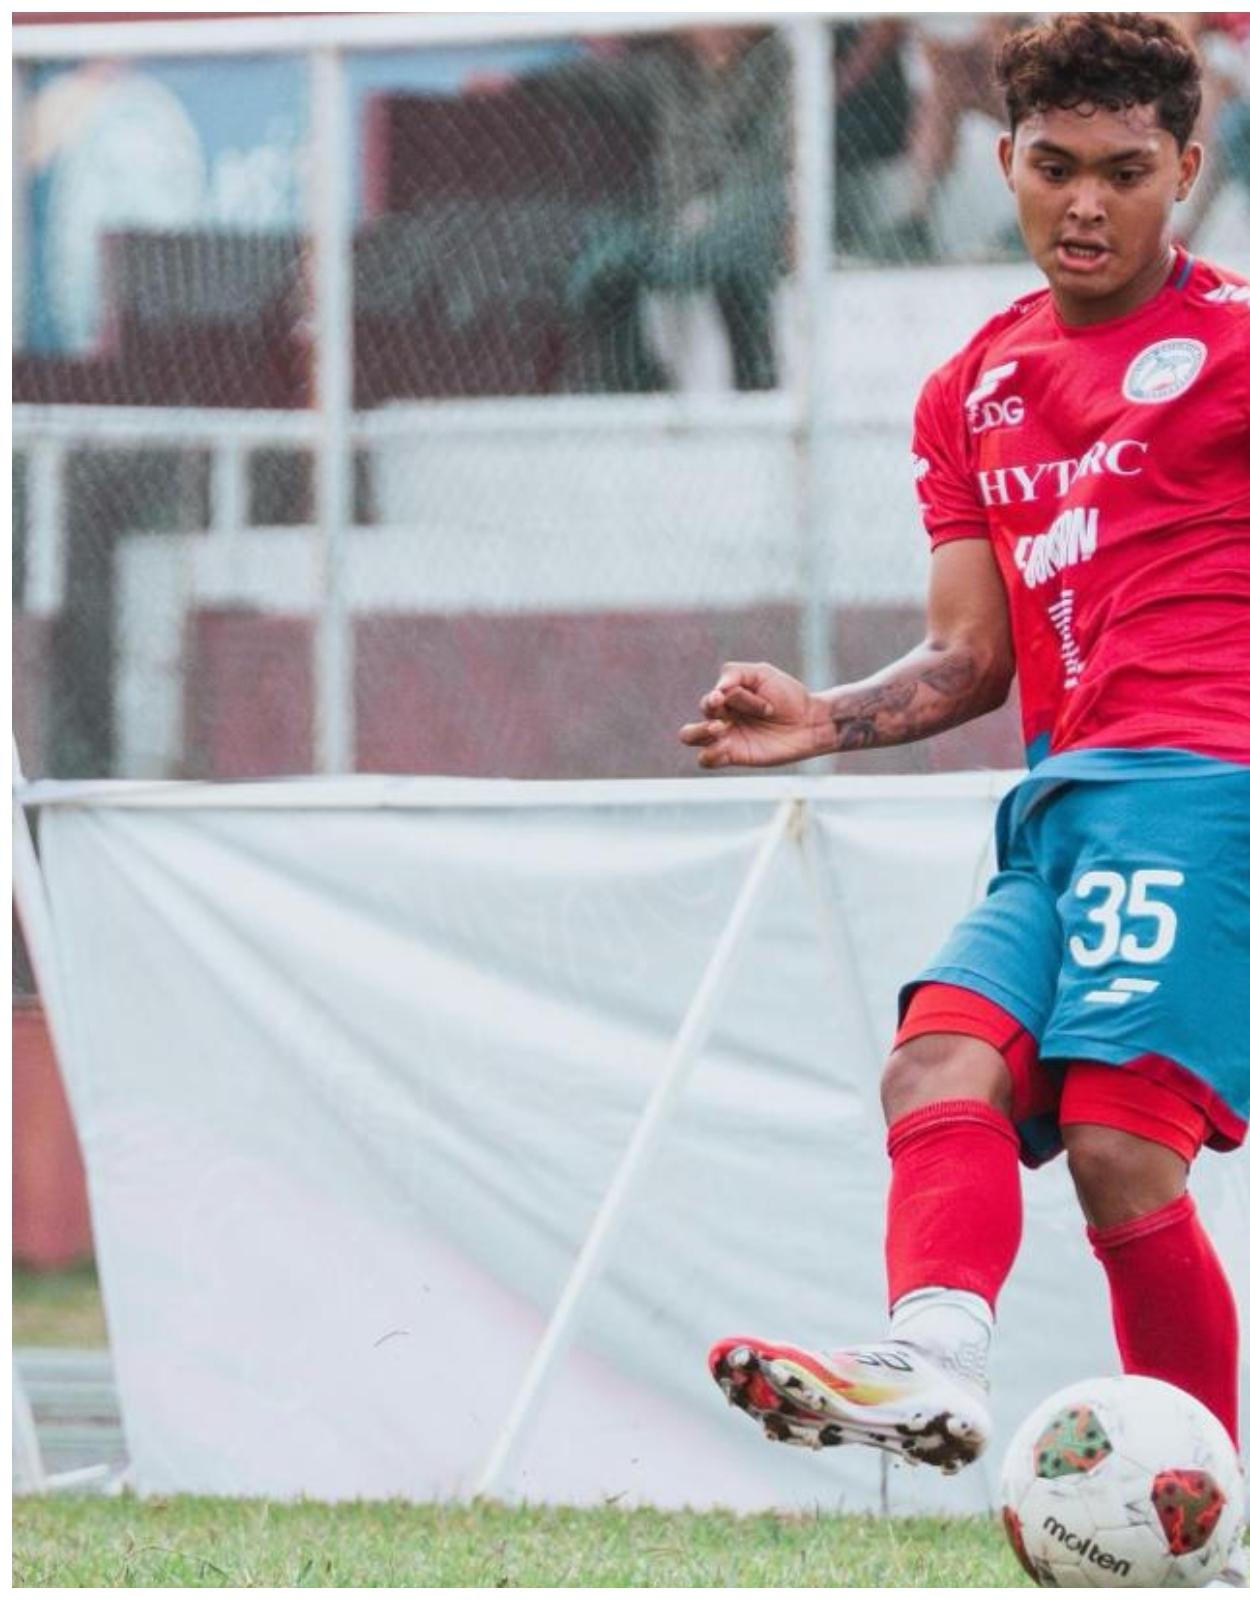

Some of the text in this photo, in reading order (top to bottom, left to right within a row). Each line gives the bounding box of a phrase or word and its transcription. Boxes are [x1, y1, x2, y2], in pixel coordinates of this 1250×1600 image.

[977, 439, 1149, 507] HYTRC
[1069, 868, 1185, 968] 35
[1042, 1514, 1132, 1578] molten
